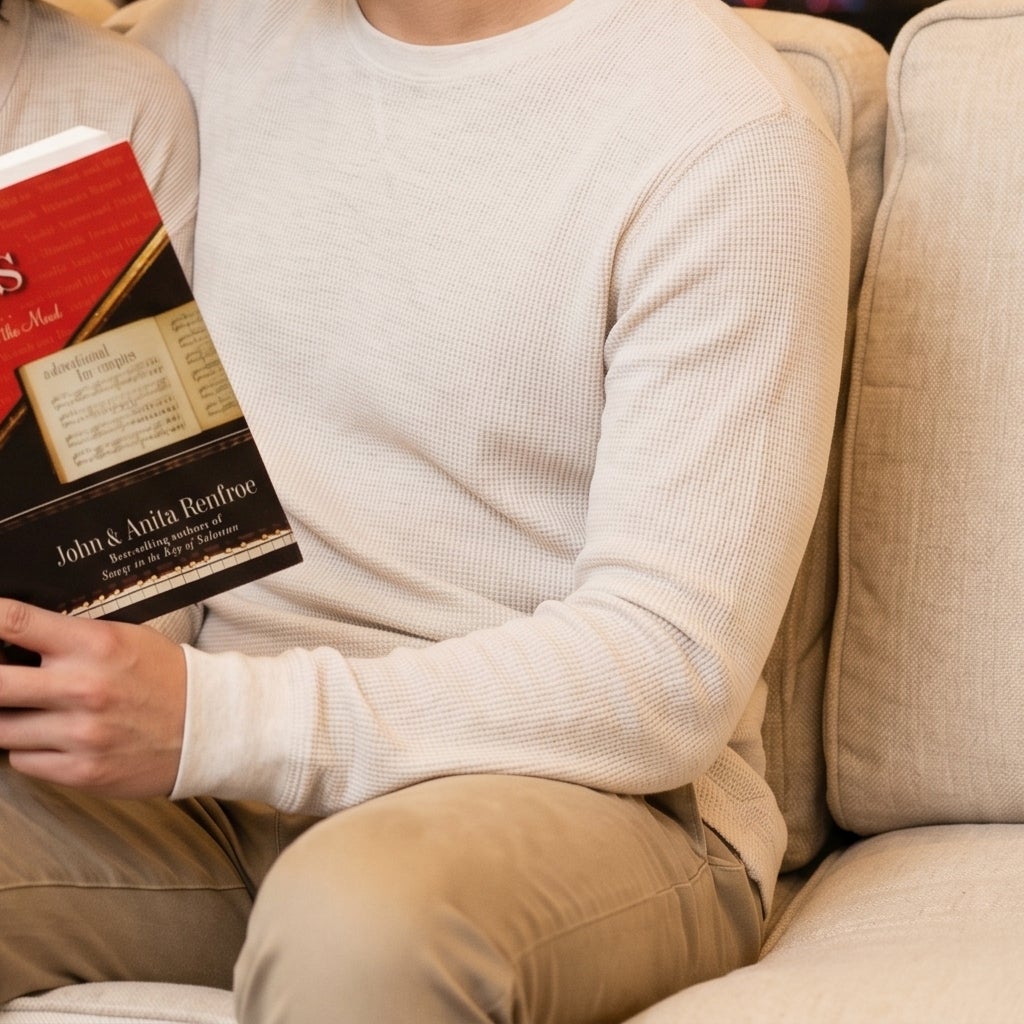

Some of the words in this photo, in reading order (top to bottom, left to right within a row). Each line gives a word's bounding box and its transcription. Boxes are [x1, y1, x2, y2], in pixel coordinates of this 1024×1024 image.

[56, 538, 104, 568] John
[107, 527, 123, 547] &
[126, 509, 180, 541] Anita
[179, 478, 259, 519] Renfroe
[212, 513, 223, 526] of
